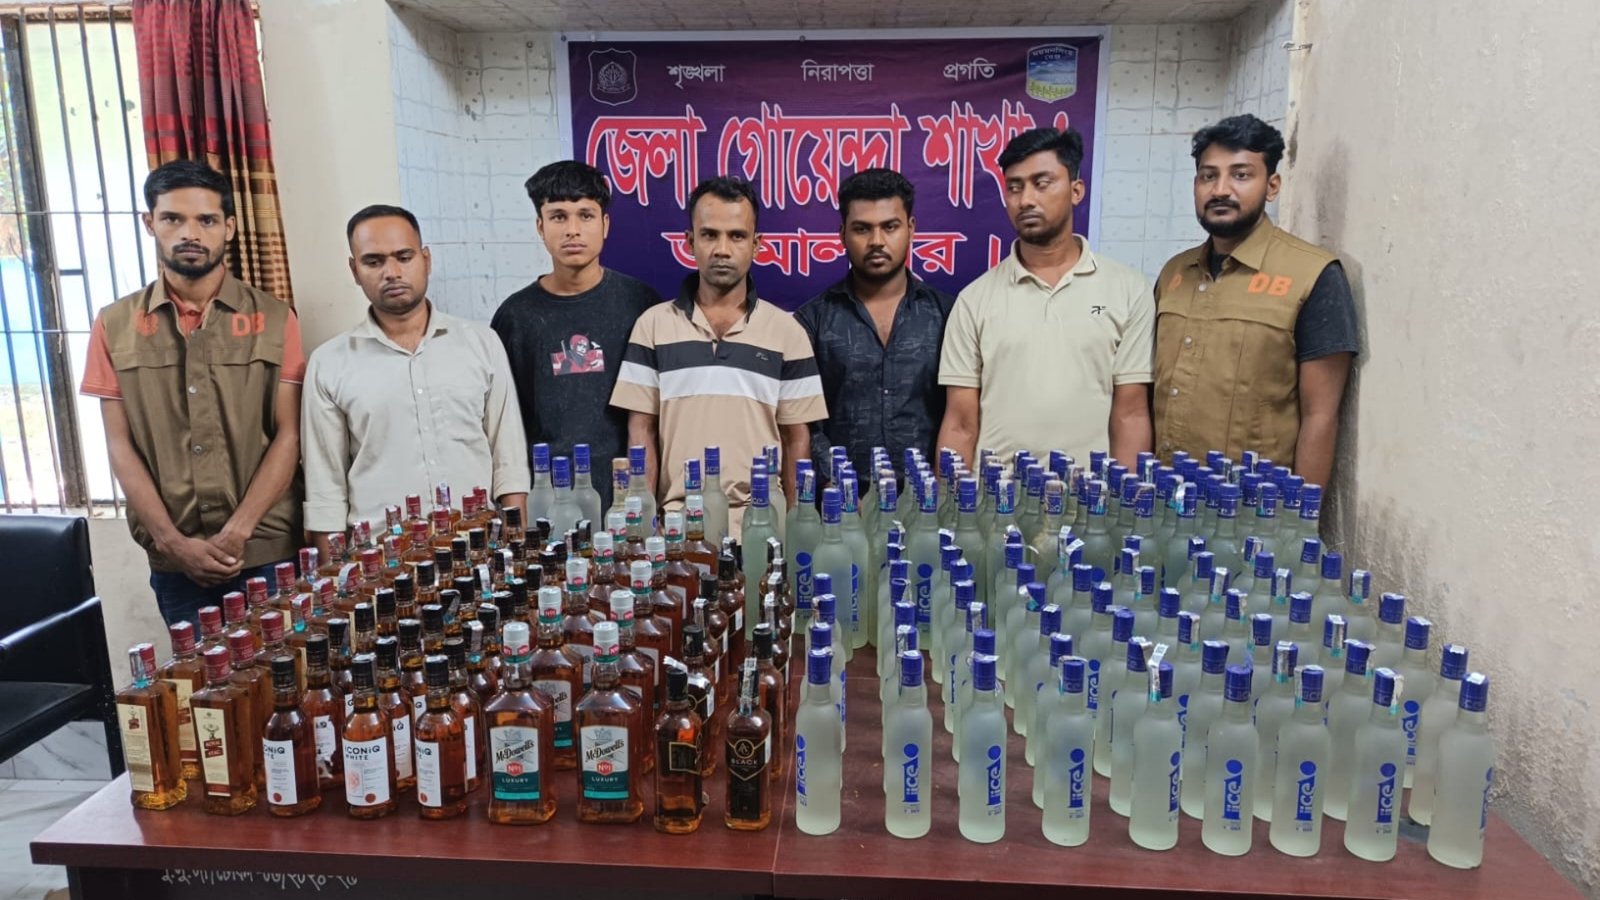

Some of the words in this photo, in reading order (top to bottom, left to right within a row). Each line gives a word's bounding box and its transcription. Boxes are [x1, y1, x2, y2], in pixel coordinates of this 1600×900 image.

[666, 64, 726, 89] শৃঙ্খলা
[801, 59, 875, 83] নিরাপত্তা
[943, 58, 996, 83] প্রগতি
[585, 103, 706, 210] জেলা
[717, 101, 911, 210] গোয়েন্দা
[917, 99, 1036, 209] শাখ
[1248, 271, 1292, 296] DB
[496, 739, 534, 764] McDowell's
[586, 738, 625, 763] McDowell's
